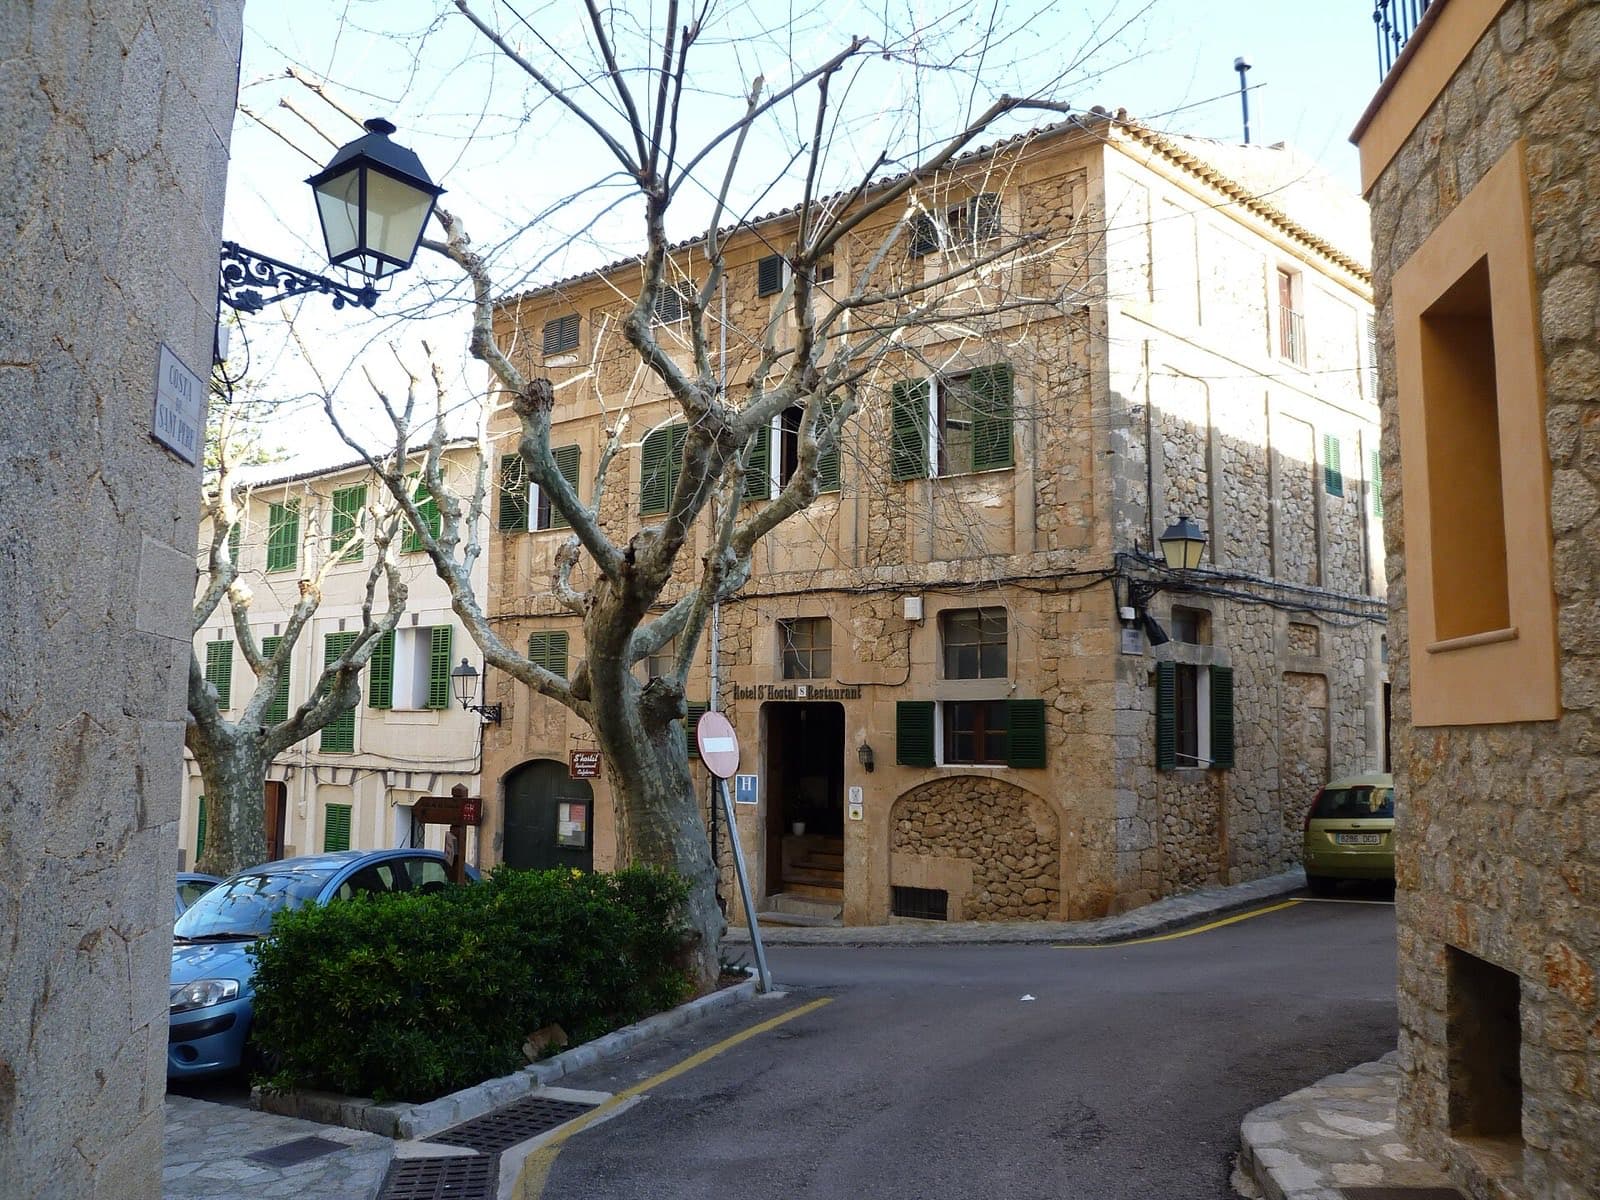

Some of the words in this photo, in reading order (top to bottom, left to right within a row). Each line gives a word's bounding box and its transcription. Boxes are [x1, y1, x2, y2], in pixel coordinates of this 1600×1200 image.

[169, 364, 192, 402] COSTA
[159, 404, 177, 438] SANT
[733, 685, 756, 700] Hotel
[807, 684, 862, 700] Restaurant
[742, 776, 752, 791] H
